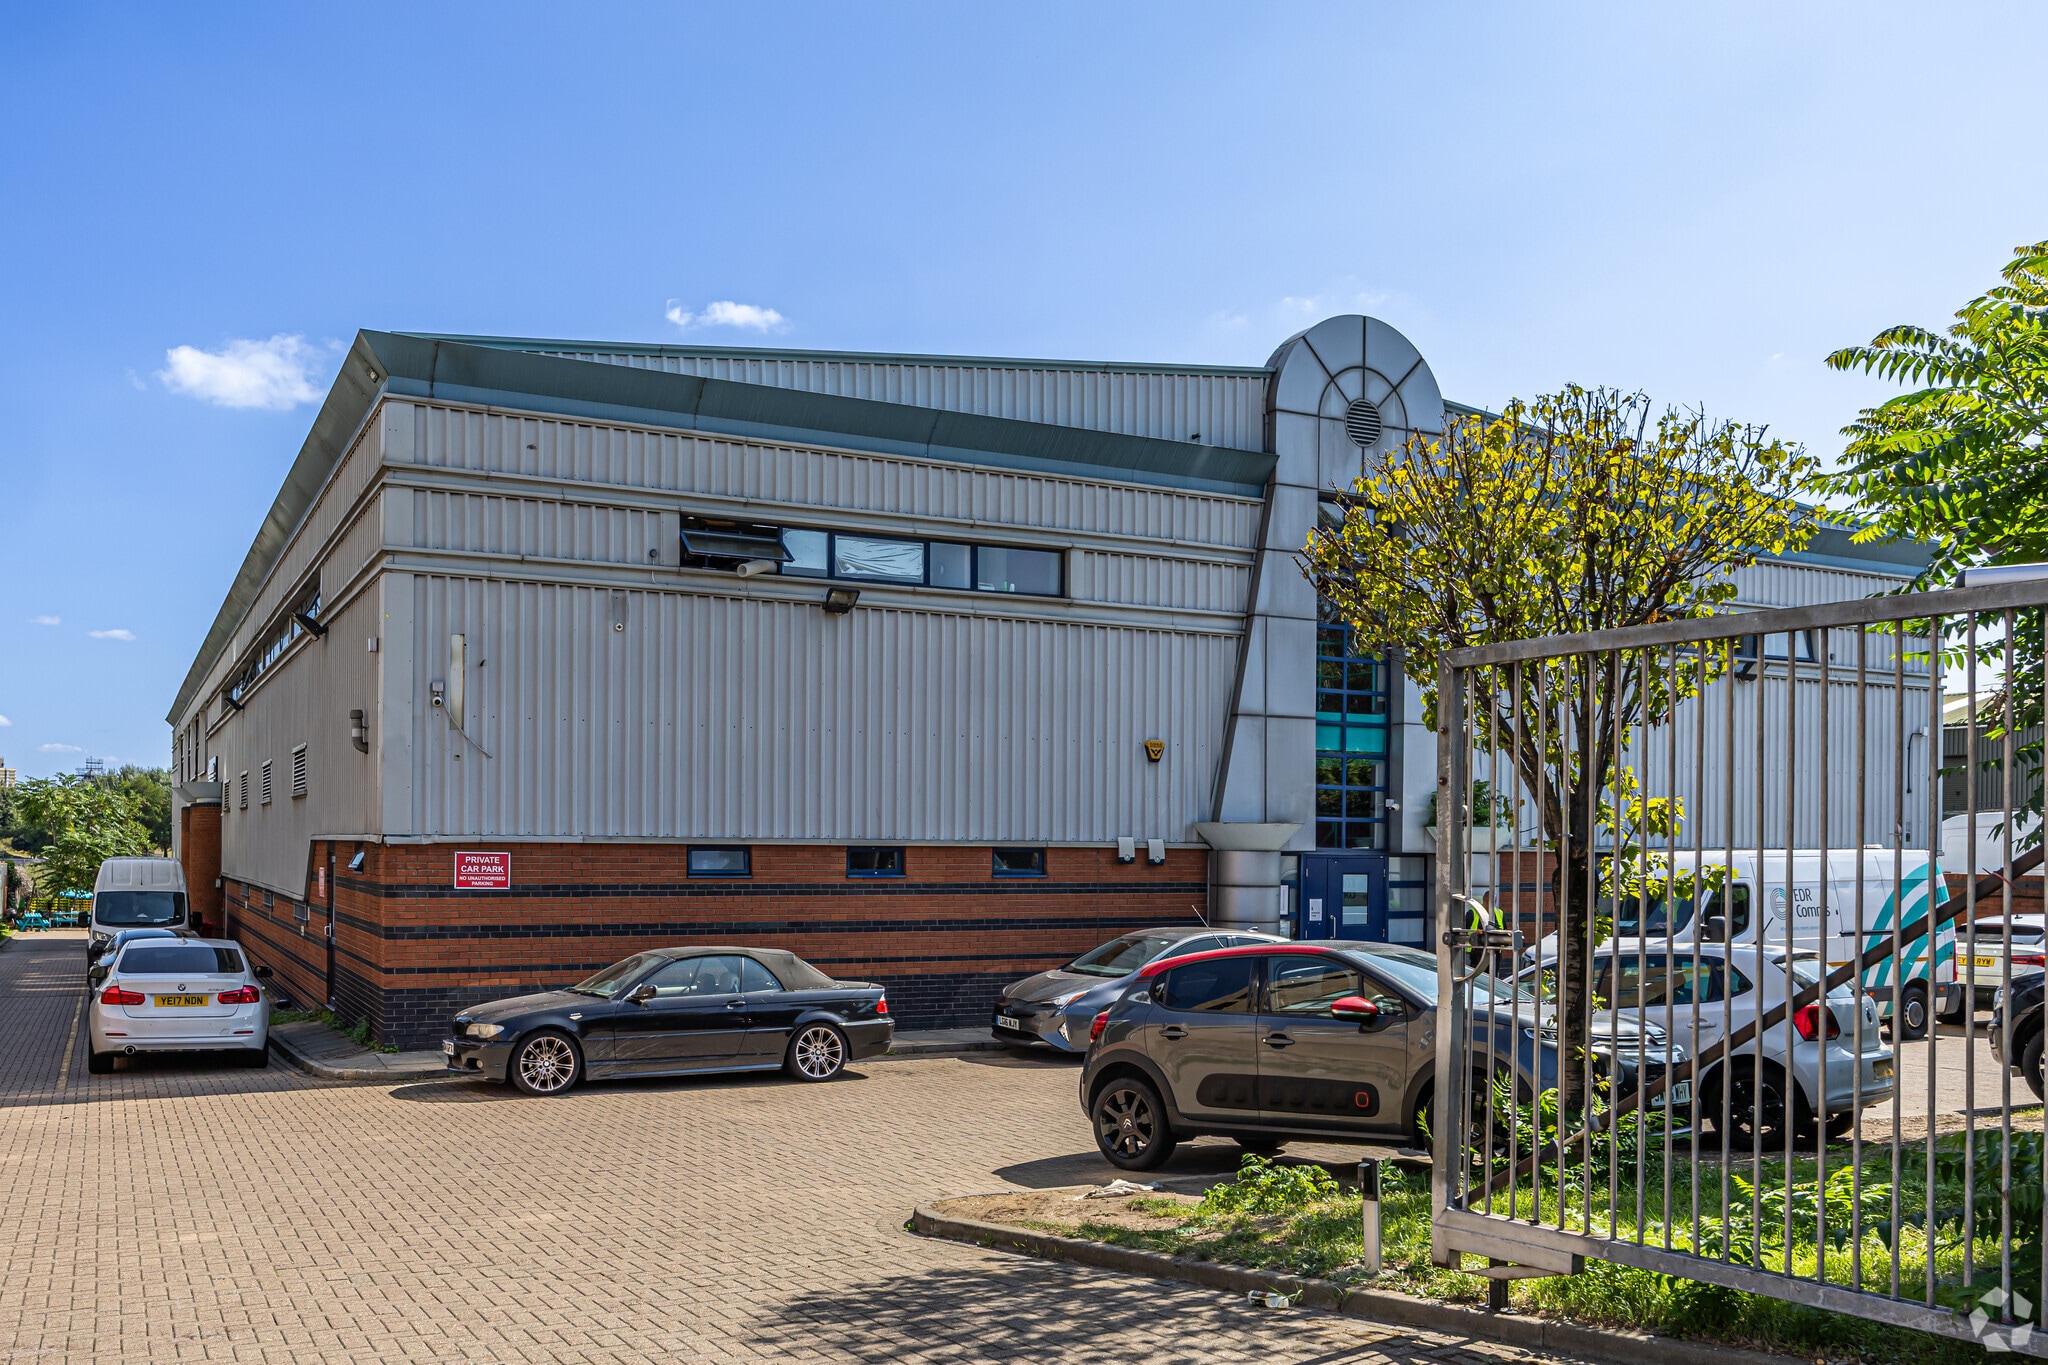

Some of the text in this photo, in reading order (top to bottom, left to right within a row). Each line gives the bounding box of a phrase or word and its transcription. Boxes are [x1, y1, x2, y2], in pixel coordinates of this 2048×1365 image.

[460, 865, 504, 873] CAR PARK
[1793, 888, 1813, 902] EDR
[160, 996, 203, 1005] YE17 NDN
